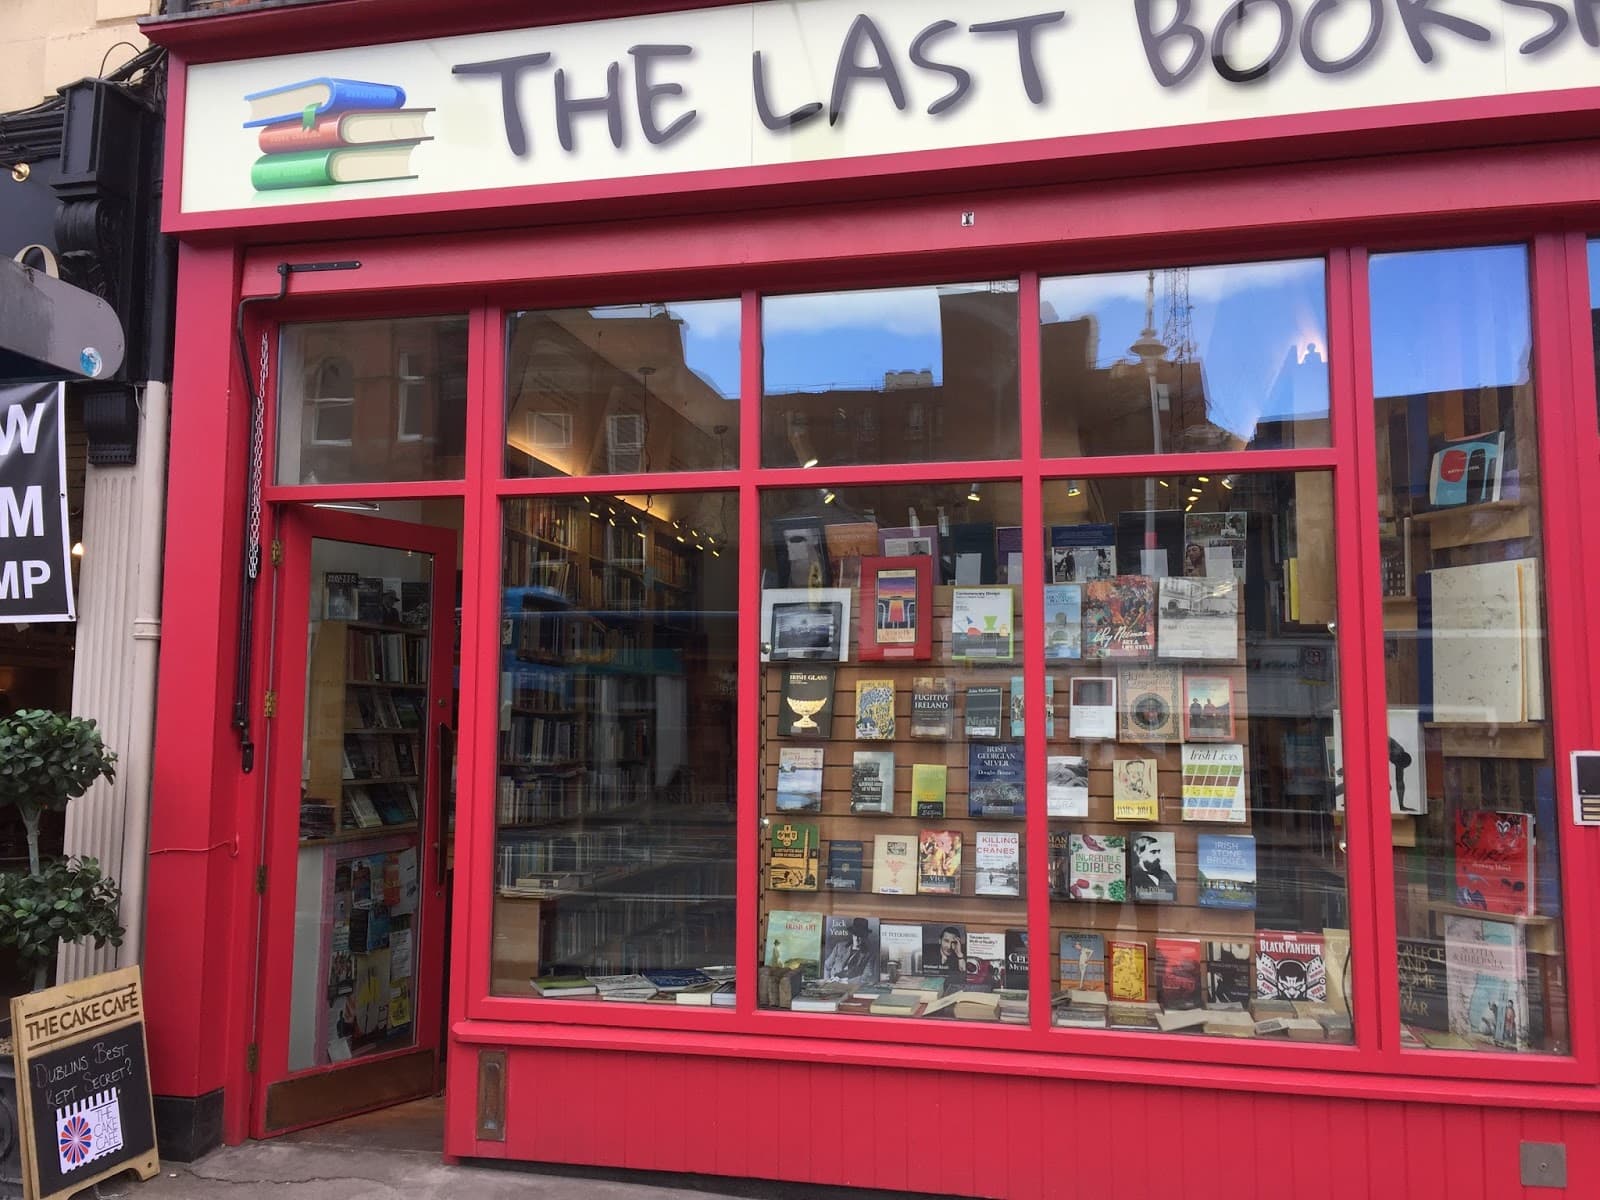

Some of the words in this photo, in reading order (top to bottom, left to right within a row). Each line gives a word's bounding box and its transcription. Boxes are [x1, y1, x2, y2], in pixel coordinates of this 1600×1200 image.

[452, 45, 697, 156] THE
[753, 11, 1066, 131] LAST
[914, 693, 949, 701] FUGITIVE
[914, 701, 949, 710] IRELAND
[1190, 749, 1210, 761] Irish
[982, 836, 1018, 844] KILLING
[1075, 853, 1121, 863] INCREDIBLE
[1075, 862, 1121, 873] EDIBLES
[832, 919, 847, 927] Jack
[829, 928, 849, 937] Yeats
[1260, 939, 1284, 953] BLACK
[1285, 941, 1321, 955] PANTHER
[25, 1016, 59, 1041] THE
[60, 1003, 102, 1031] CAKE
[95, 1105, 112, 1122] THE
[94, 1117, 118, 1137] CAKE
